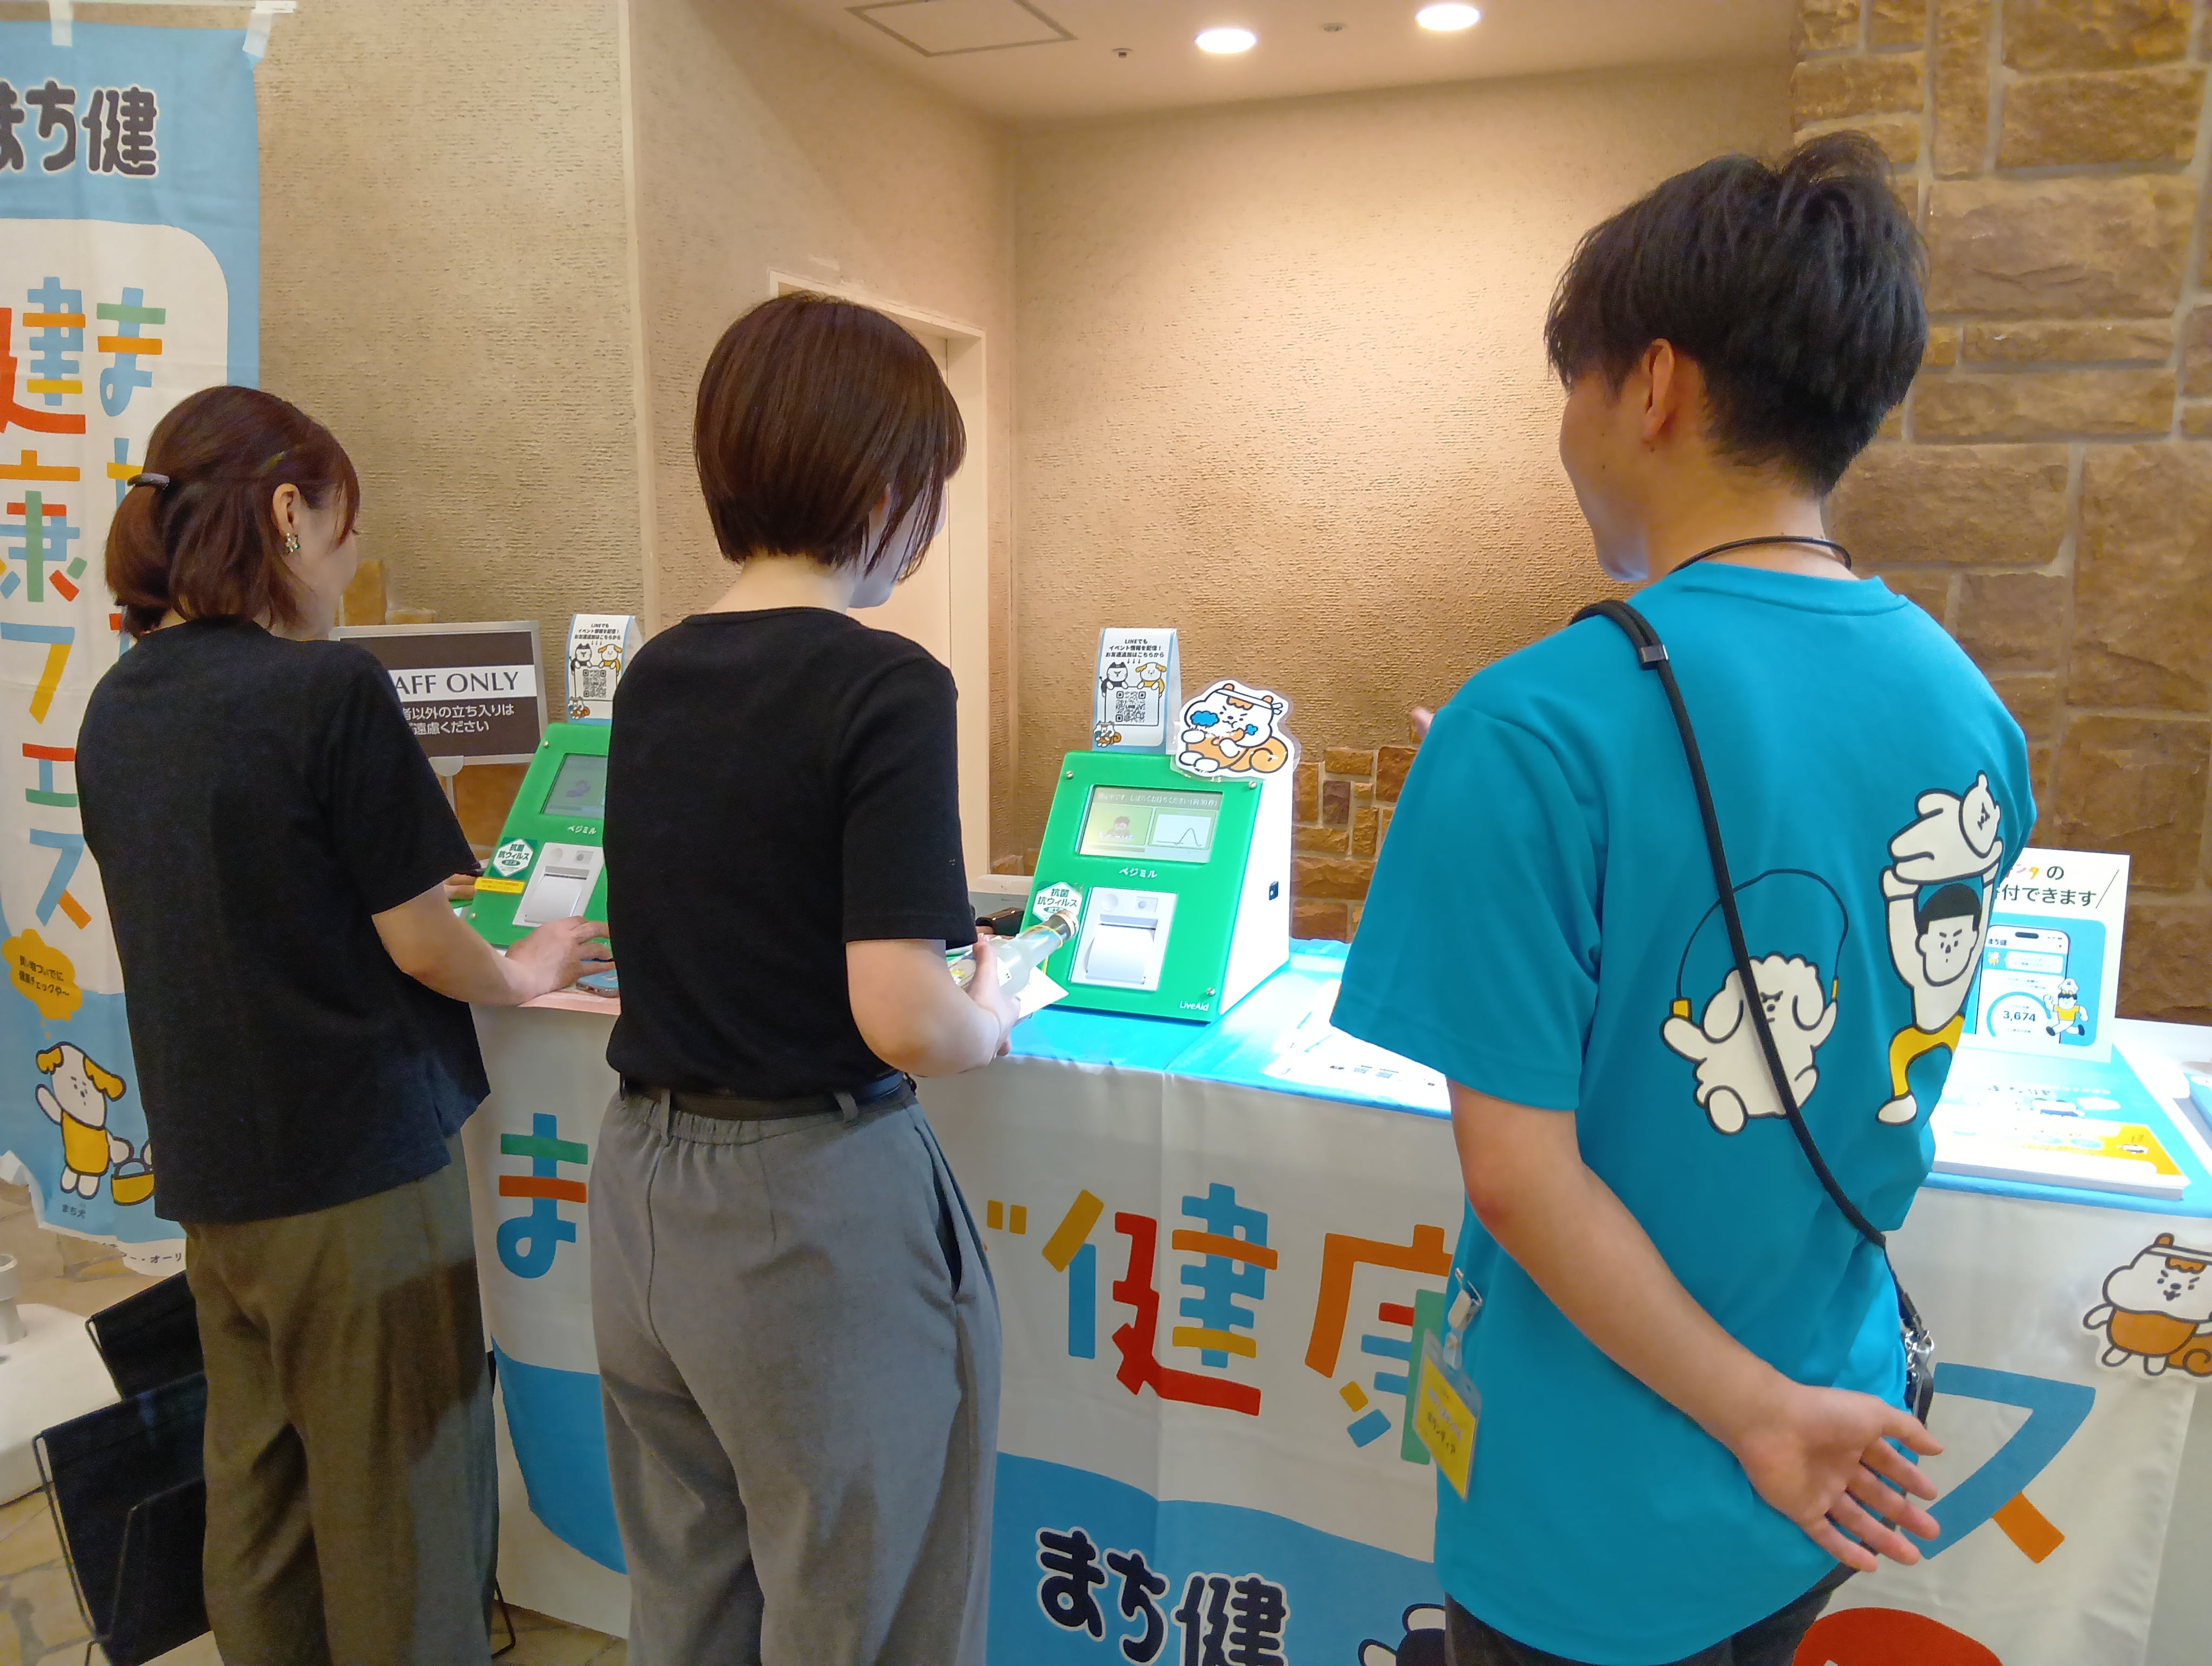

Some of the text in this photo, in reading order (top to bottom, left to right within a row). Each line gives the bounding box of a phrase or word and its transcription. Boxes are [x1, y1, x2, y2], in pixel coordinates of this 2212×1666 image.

[446, 671, 519, 693] ONLY
[568, 825, 597, 835] ベジミル
[1118, 868, 1158, 879] ベジミル
[1051, 888, 1069, 898] 抗菌
[1996, 884, 2097, 907] 付できます
[1037, 896, 1077, 907] 抗ウィルス
[1180, 1000, 1210, 1012] LiveAid
[497, 1112, 589, 1279] ま
[1038, 1528, 1288, 1666] まち健
